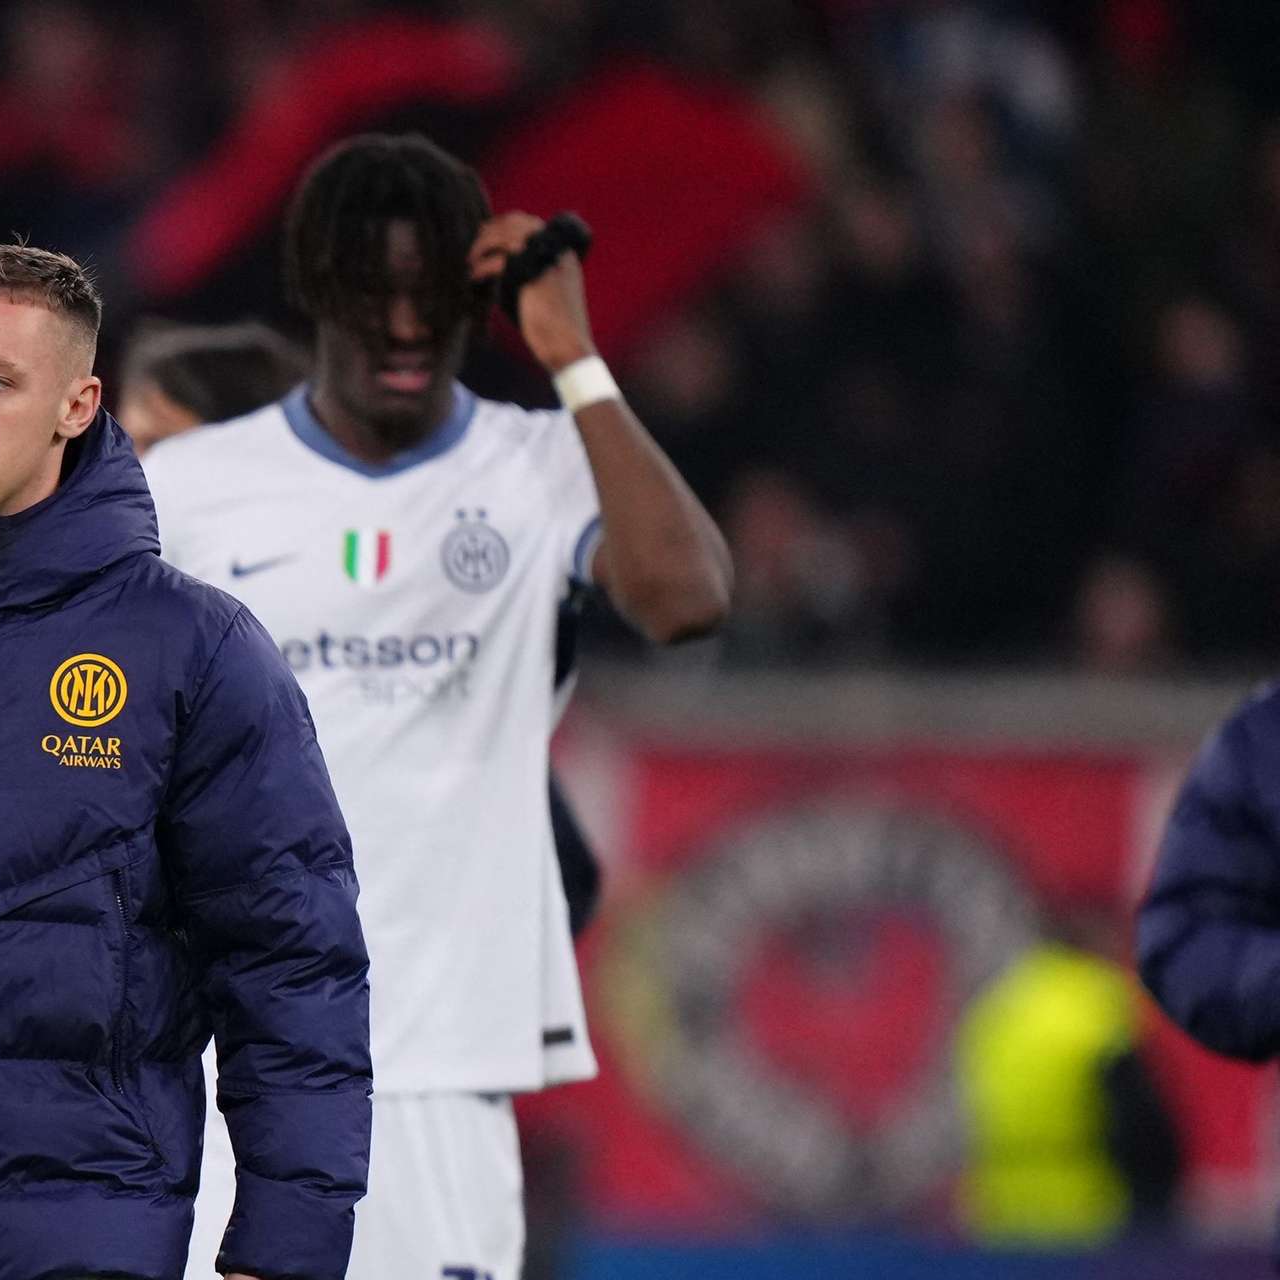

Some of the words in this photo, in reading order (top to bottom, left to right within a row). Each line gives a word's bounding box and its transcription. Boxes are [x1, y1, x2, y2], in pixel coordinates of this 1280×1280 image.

[280, 628, 480, 670] etsson
[41, 734, 122, 757] QATAR
[58, 754, 122, 770] AIRWAYS
